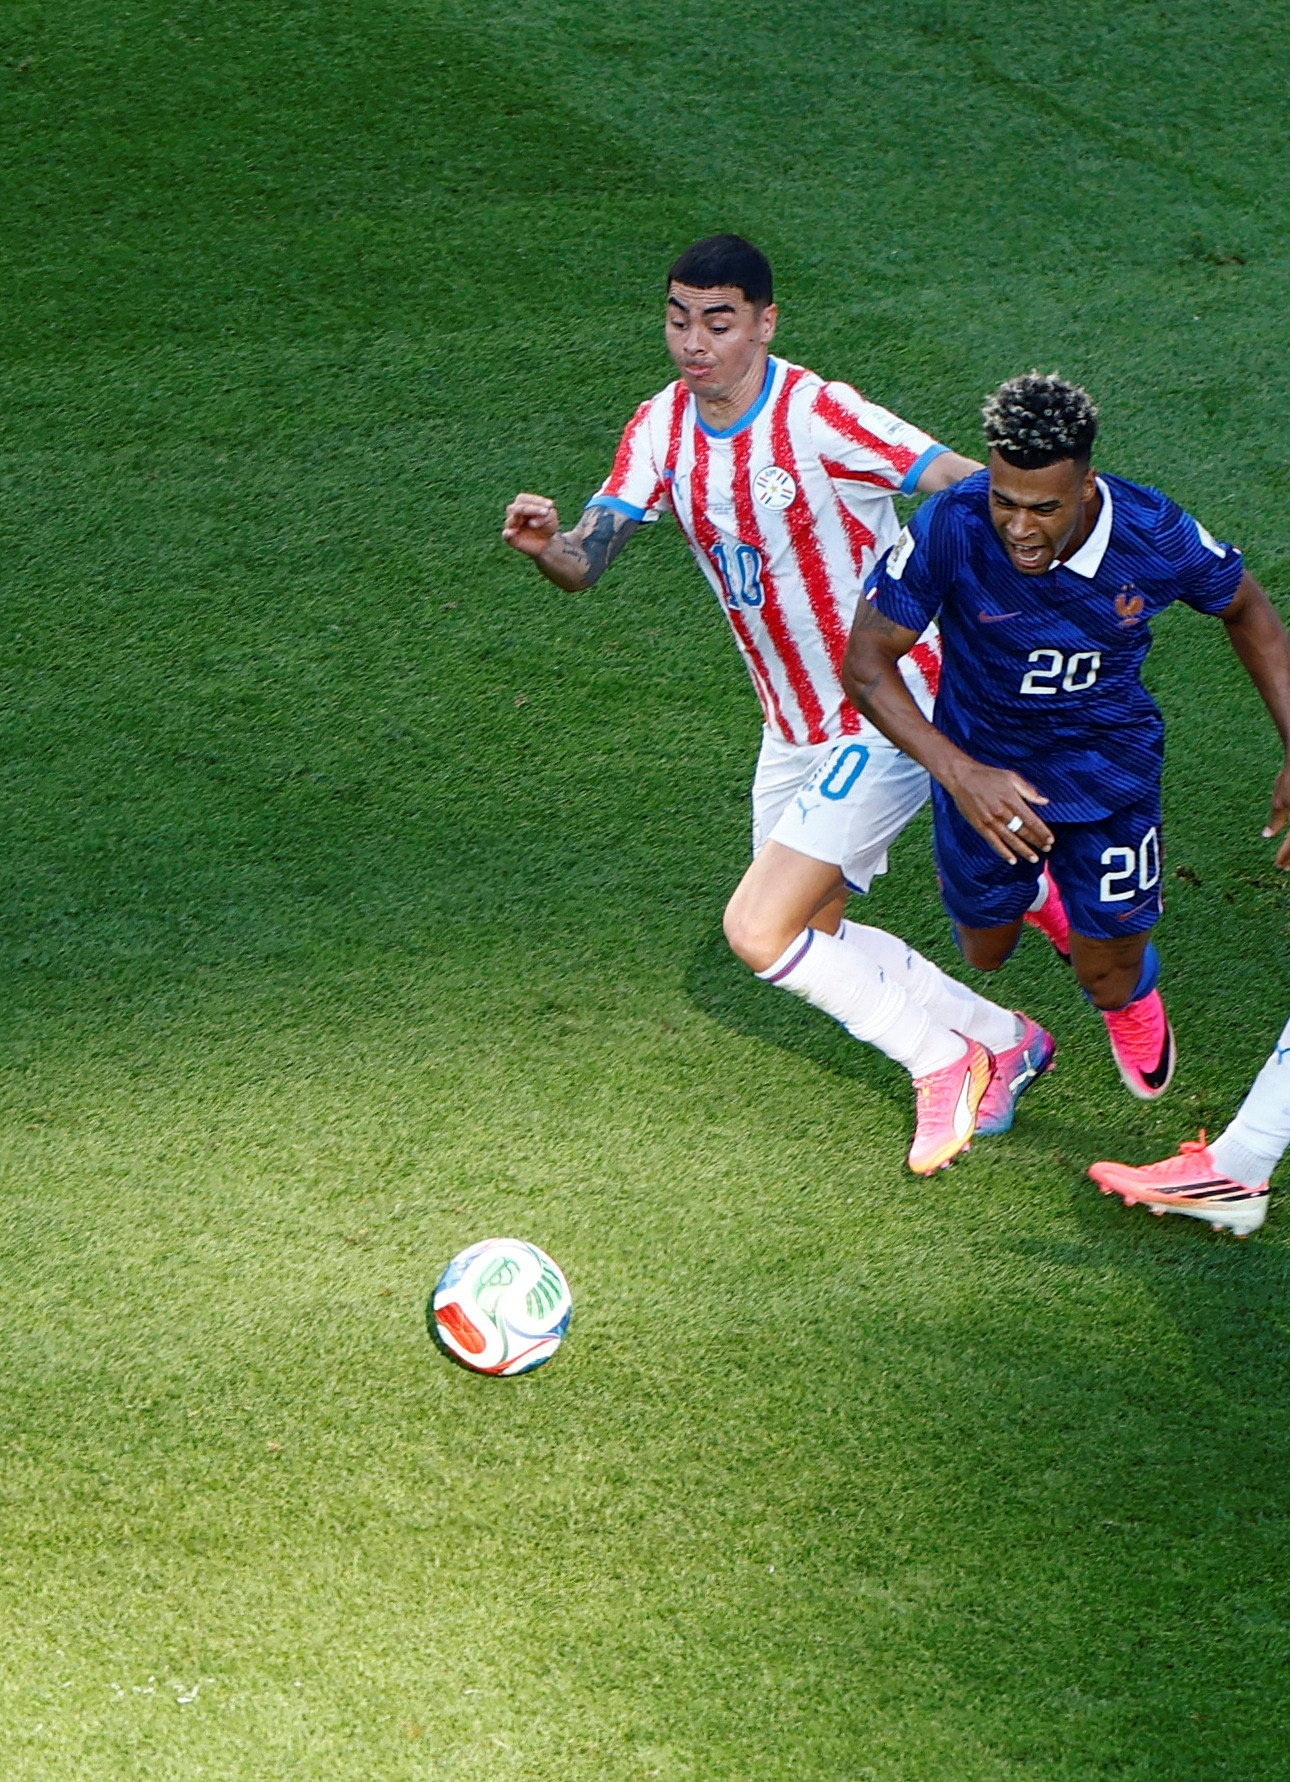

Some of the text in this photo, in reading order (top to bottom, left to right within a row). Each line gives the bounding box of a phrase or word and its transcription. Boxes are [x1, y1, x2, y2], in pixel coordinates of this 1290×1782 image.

[711, 543, 765, 609] 10
[1019, 649, 1101, 695] 20
[802, 743, 870, 801] 0
[1099, 826, 1159, 902] 20
